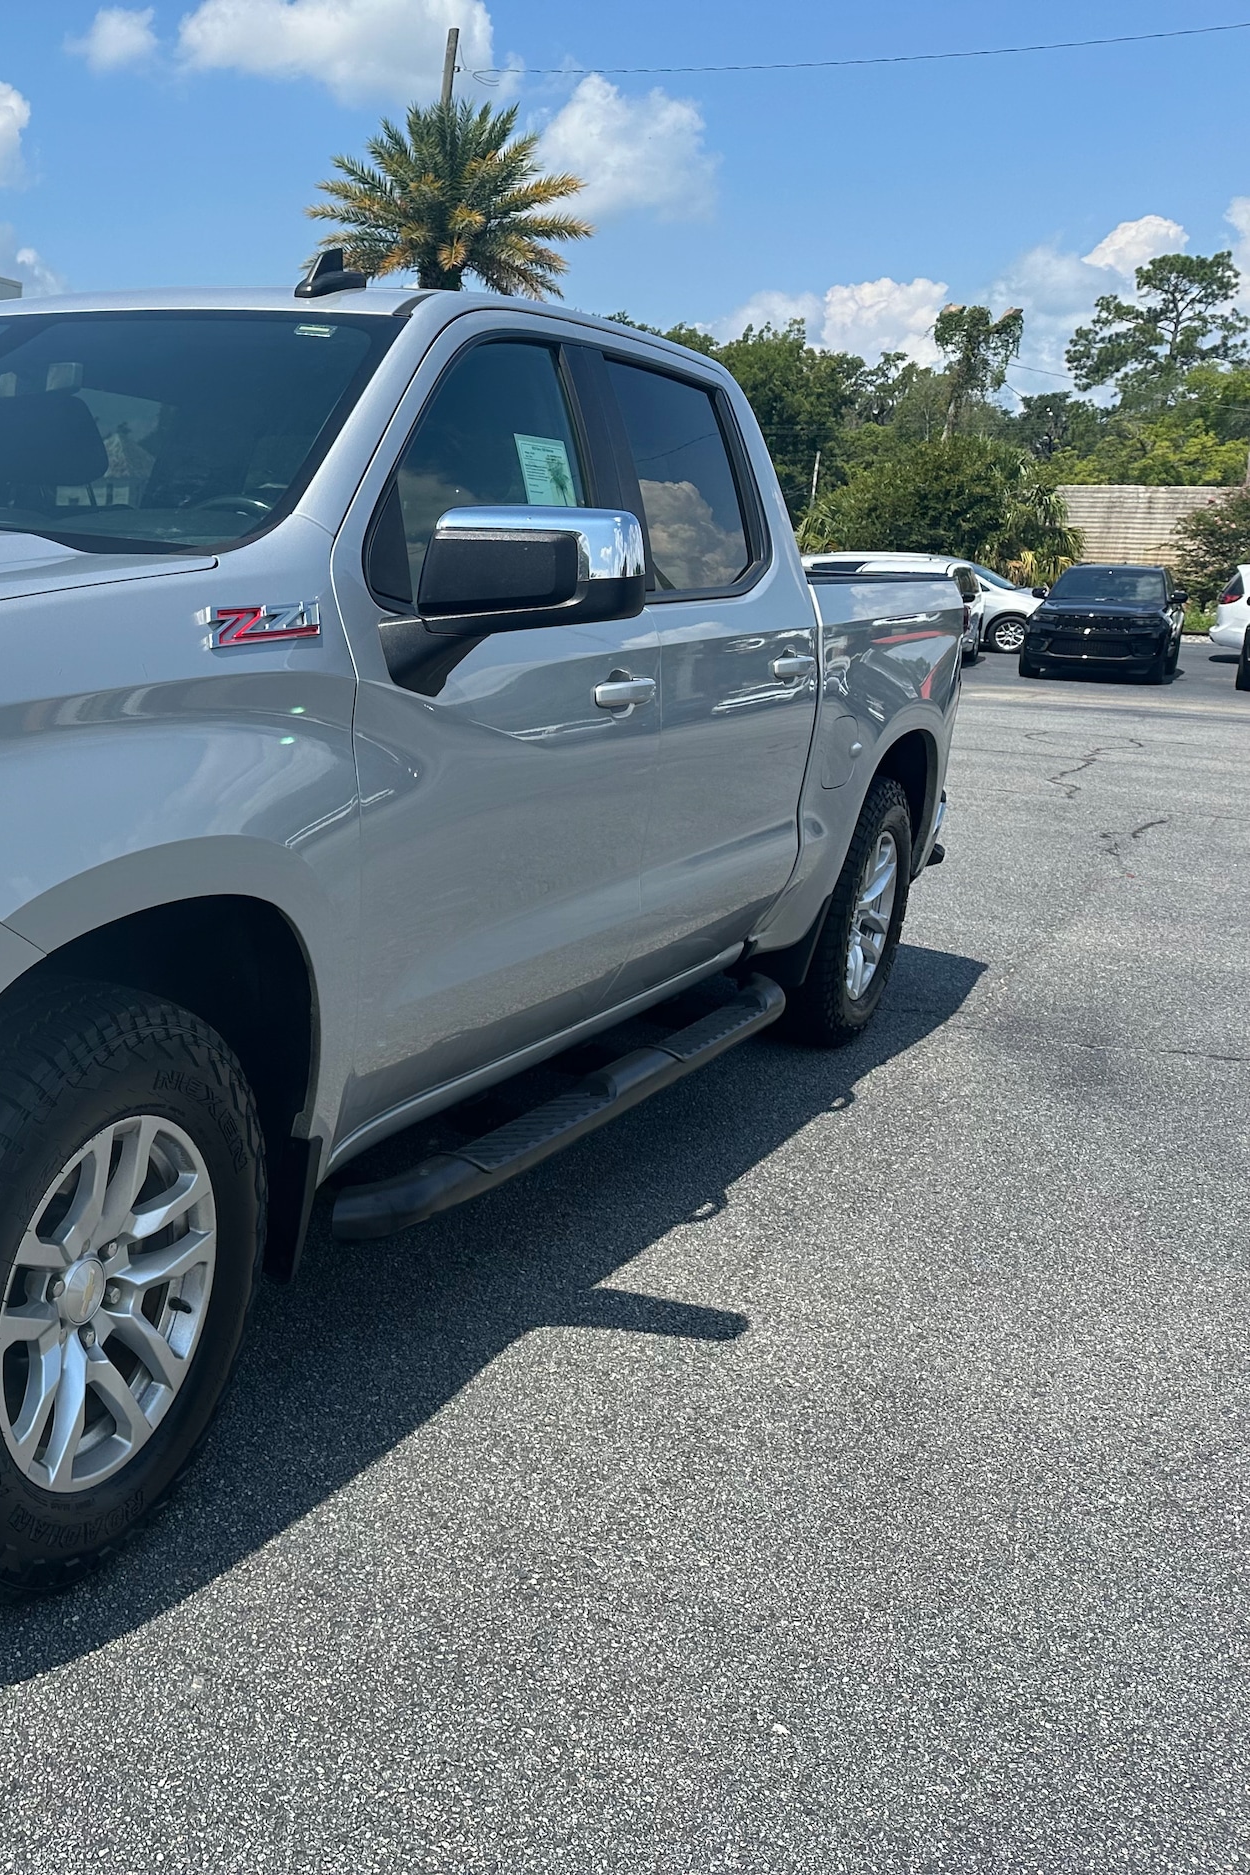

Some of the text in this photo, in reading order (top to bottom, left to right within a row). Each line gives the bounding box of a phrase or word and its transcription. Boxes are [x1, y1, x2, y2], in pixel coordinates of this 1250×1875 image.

[198, 597, 321, 649] Z71
[153, 1069, 249, 1175] NEXEN
[7, 1487, 145, 1548] ROADIAN
